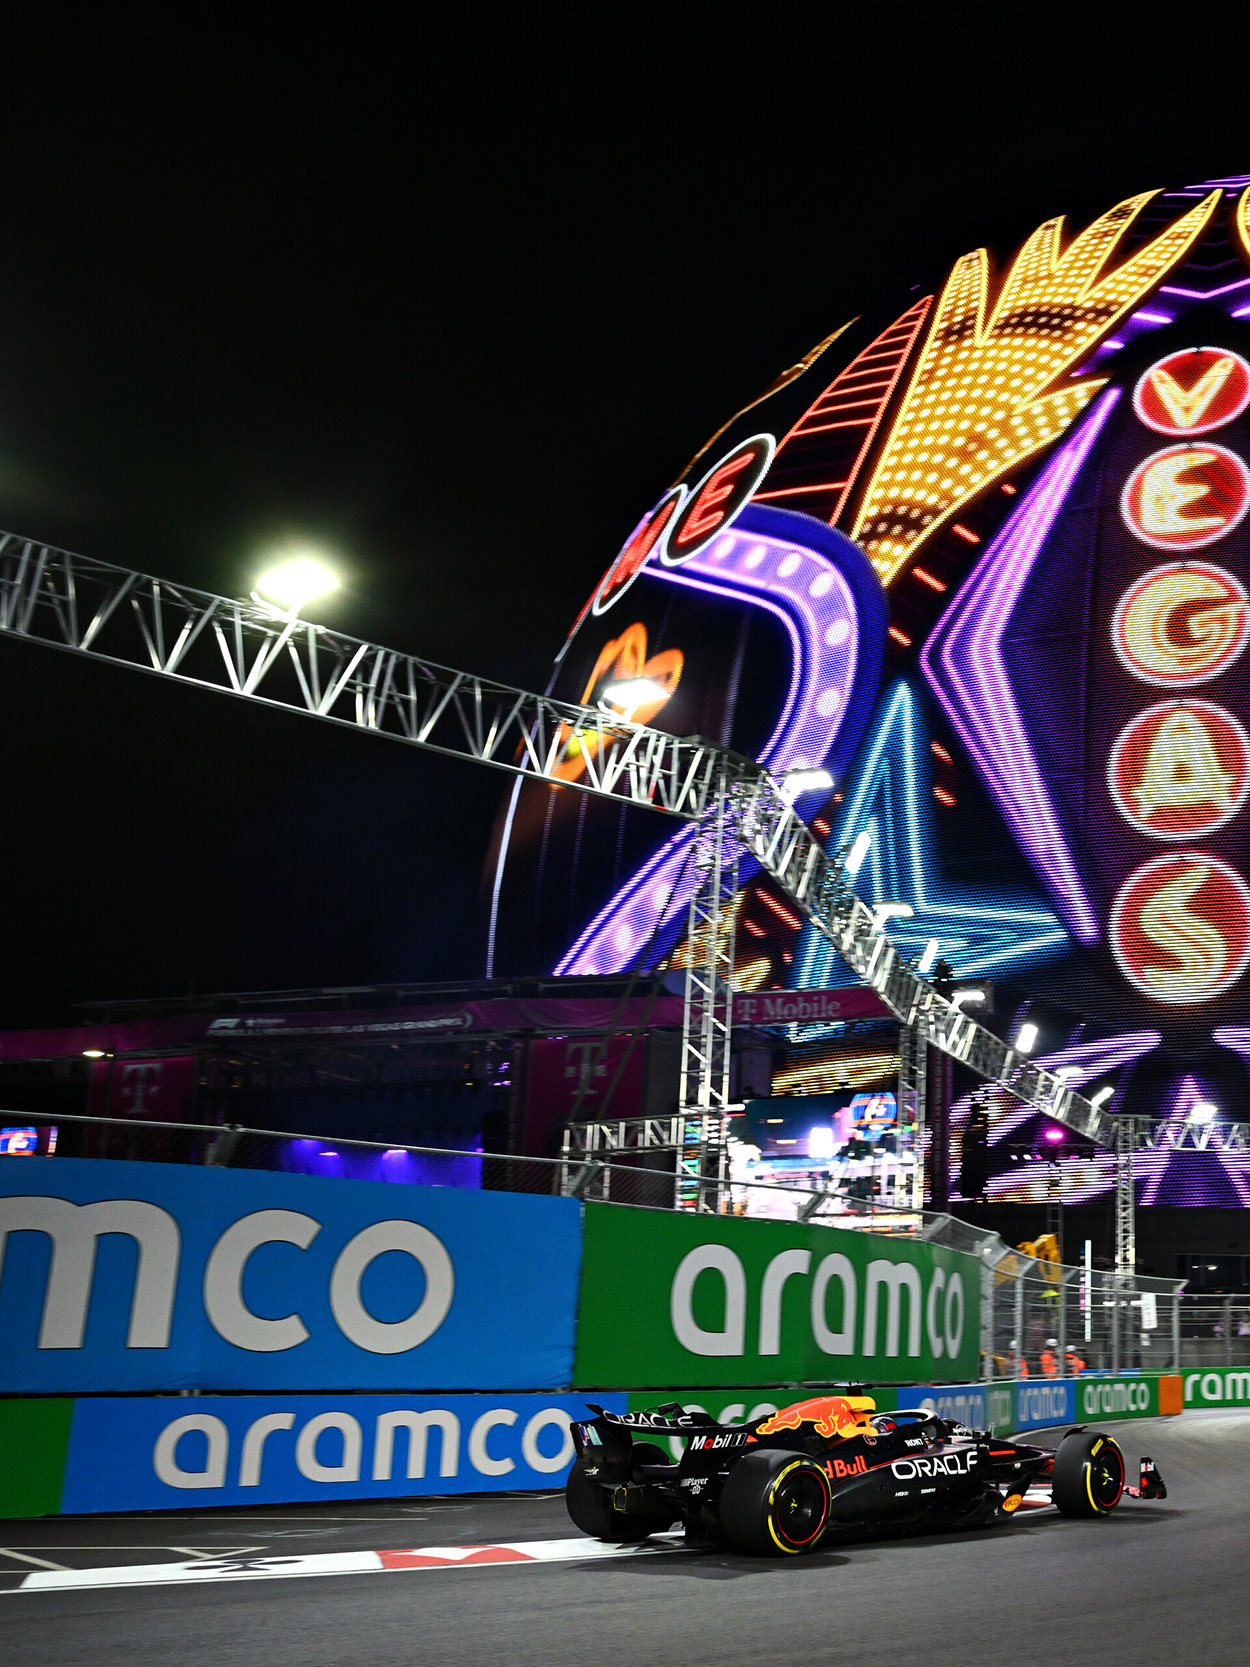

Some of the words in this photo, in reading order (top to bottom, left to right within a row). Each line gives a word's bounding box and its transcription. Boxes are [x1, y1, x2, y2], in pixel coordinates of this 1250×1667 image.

[1125, 356, 1249, 992] VEGAS
[671, 1243, 964, 1360] aramco
[1084, 1382, 1149, 1415] aramco
[154, 1408, 577, 1489] aramco
[690, 1434, 733, 1450] Mobil
[833, 1455, 868, 1478] Bull
